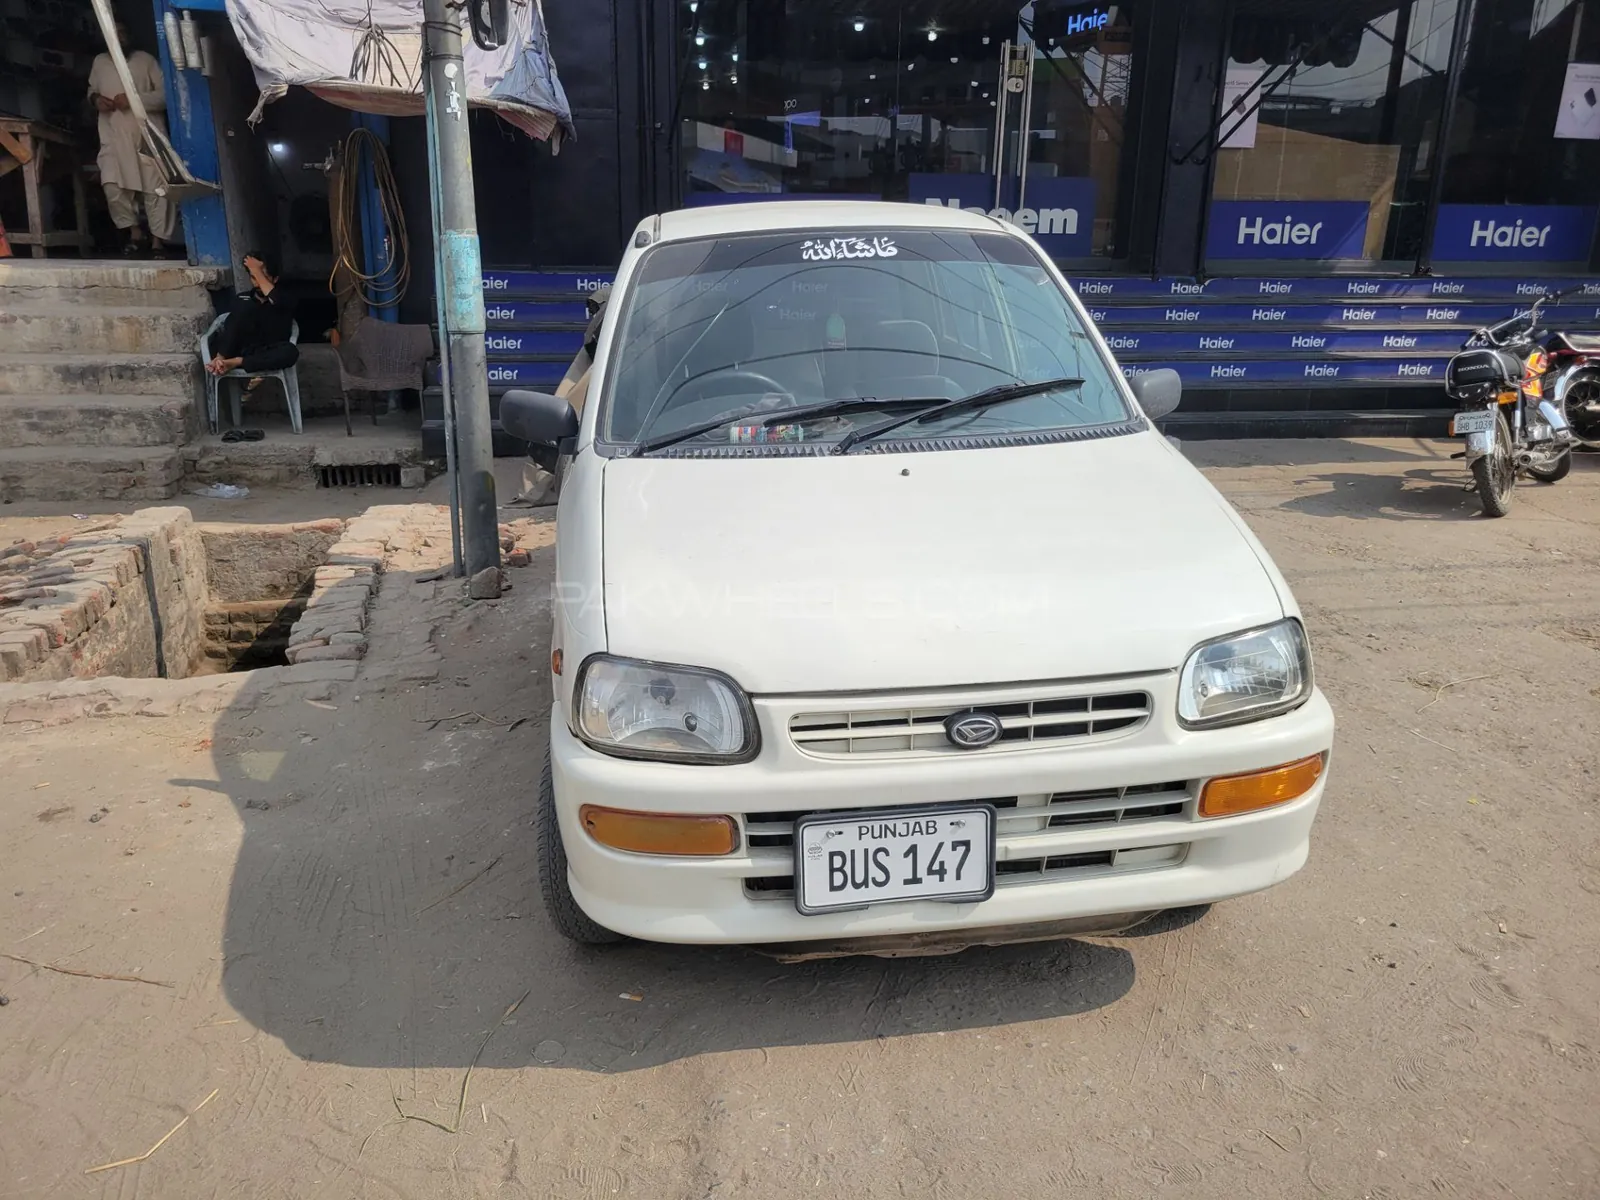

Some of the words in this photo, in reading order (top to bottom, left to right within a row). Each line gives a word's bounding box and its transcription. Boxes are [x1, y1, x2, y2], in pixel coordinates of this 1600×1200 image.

[1067, 8, 1108, 35] Haie
[1237, 216, 1322, 245] Haier
[1470, 219, 1551, 247] Haier
[481, 276, 508, 289] aier
[1079, 282, 1113, 294] Haier
[1171, 282, 1205, 294] Haier
[1259, 282, 1292, 293] Haier
[1347, 282, 1380, 294] Haier
[1432, 282, 1464, 294] Haier
[1516, 283, 1547, 295] Haier
[486, 306, 515, 319] aier
[1089, 310, 1106, 321] ier
[1165, 309, 1200, 321] Haier
[1252, 309, 1286, 320] Haier
[1342, 309, 1376, 320] Haier
[1426, 308, 1460, 320] Haier
[1200, 337, 1234, 349] Haier
[1292, 336, 1326, 347] Haier
[1382, 335, 1417, 347] Haier
[488, 366, 518, 380] aier
[1211, 365, 1246, 377] Haier
[1304, 365, 1339, 376] Haier
[1398, 364, 1432, 375] Haier
[858, 820, 938, 840] PUNJAB
[829, 847, 890, 892] BUS
[903, 840, 971, 885] 147
